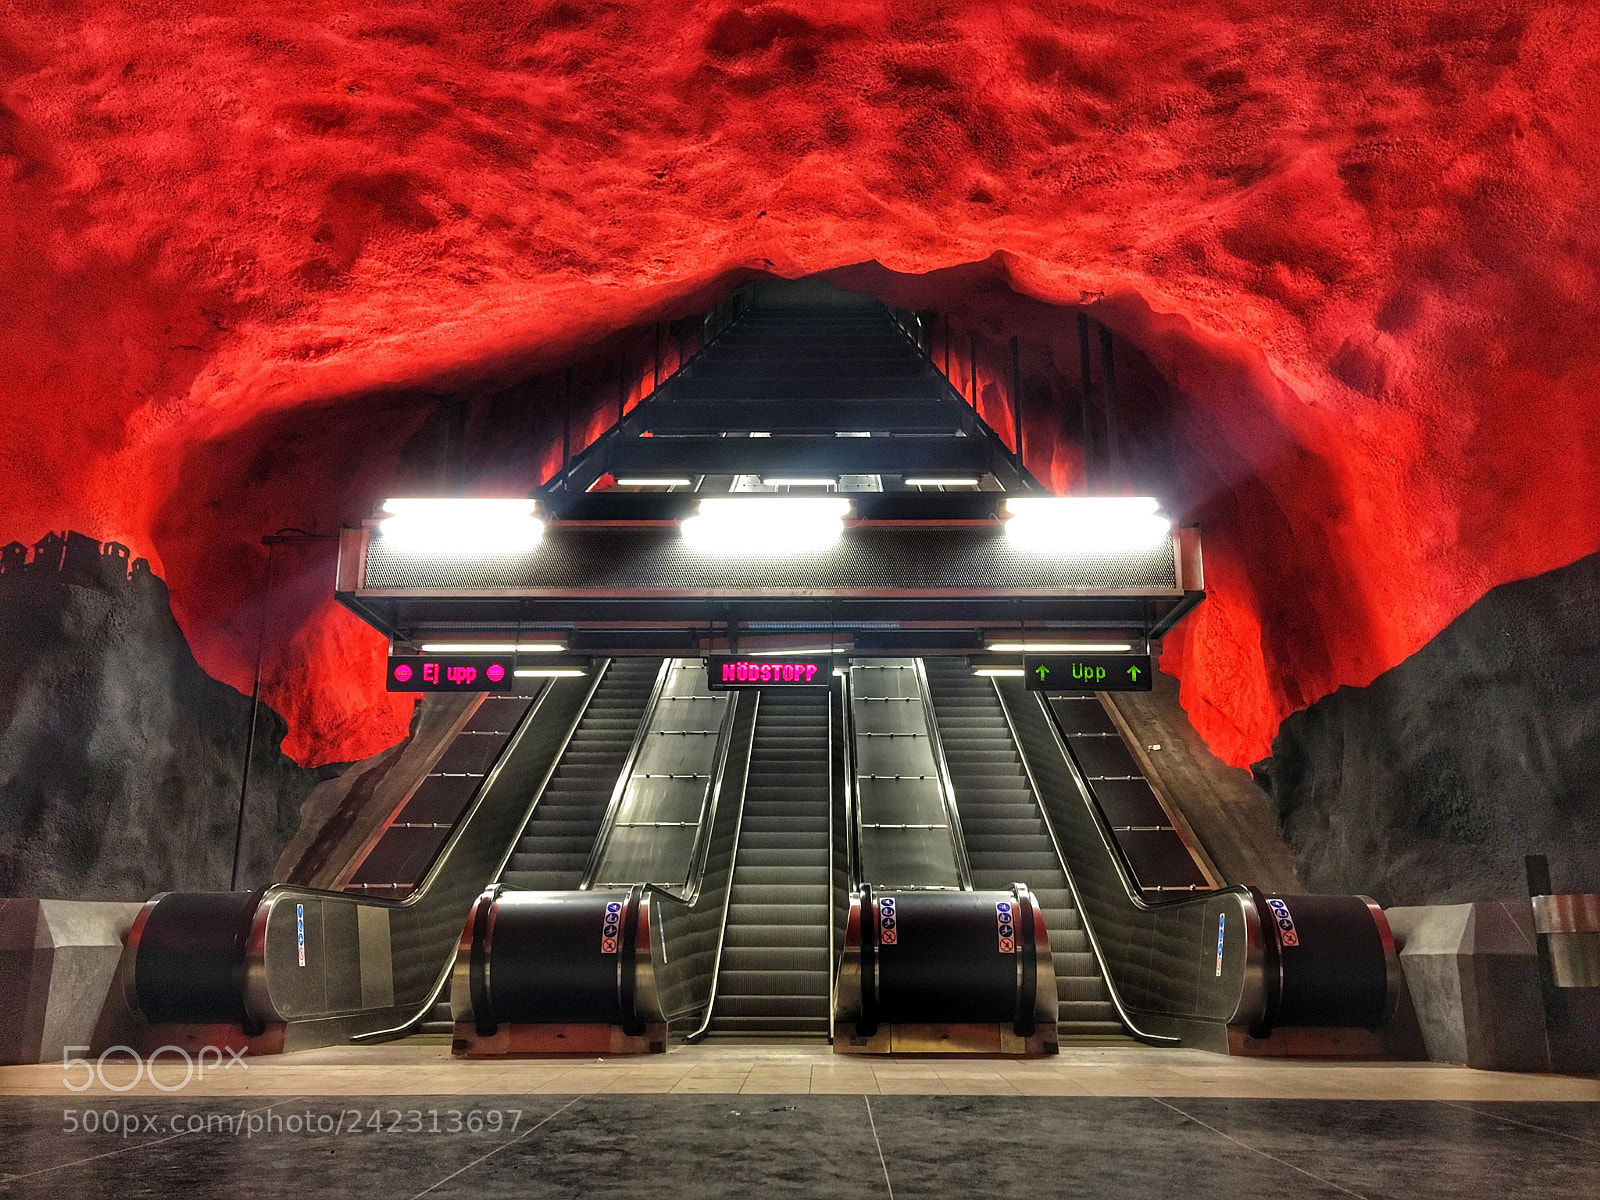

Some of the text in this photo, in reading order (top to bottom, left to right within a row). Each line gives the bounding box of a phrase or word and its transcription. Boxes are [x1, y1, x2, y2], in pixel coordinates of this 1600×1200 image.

[423, 663, 477, 684] Ej upp
[722, 661, 818, 682] NÖDSTOPP
[1072, 663, 1106, 682] Upp
